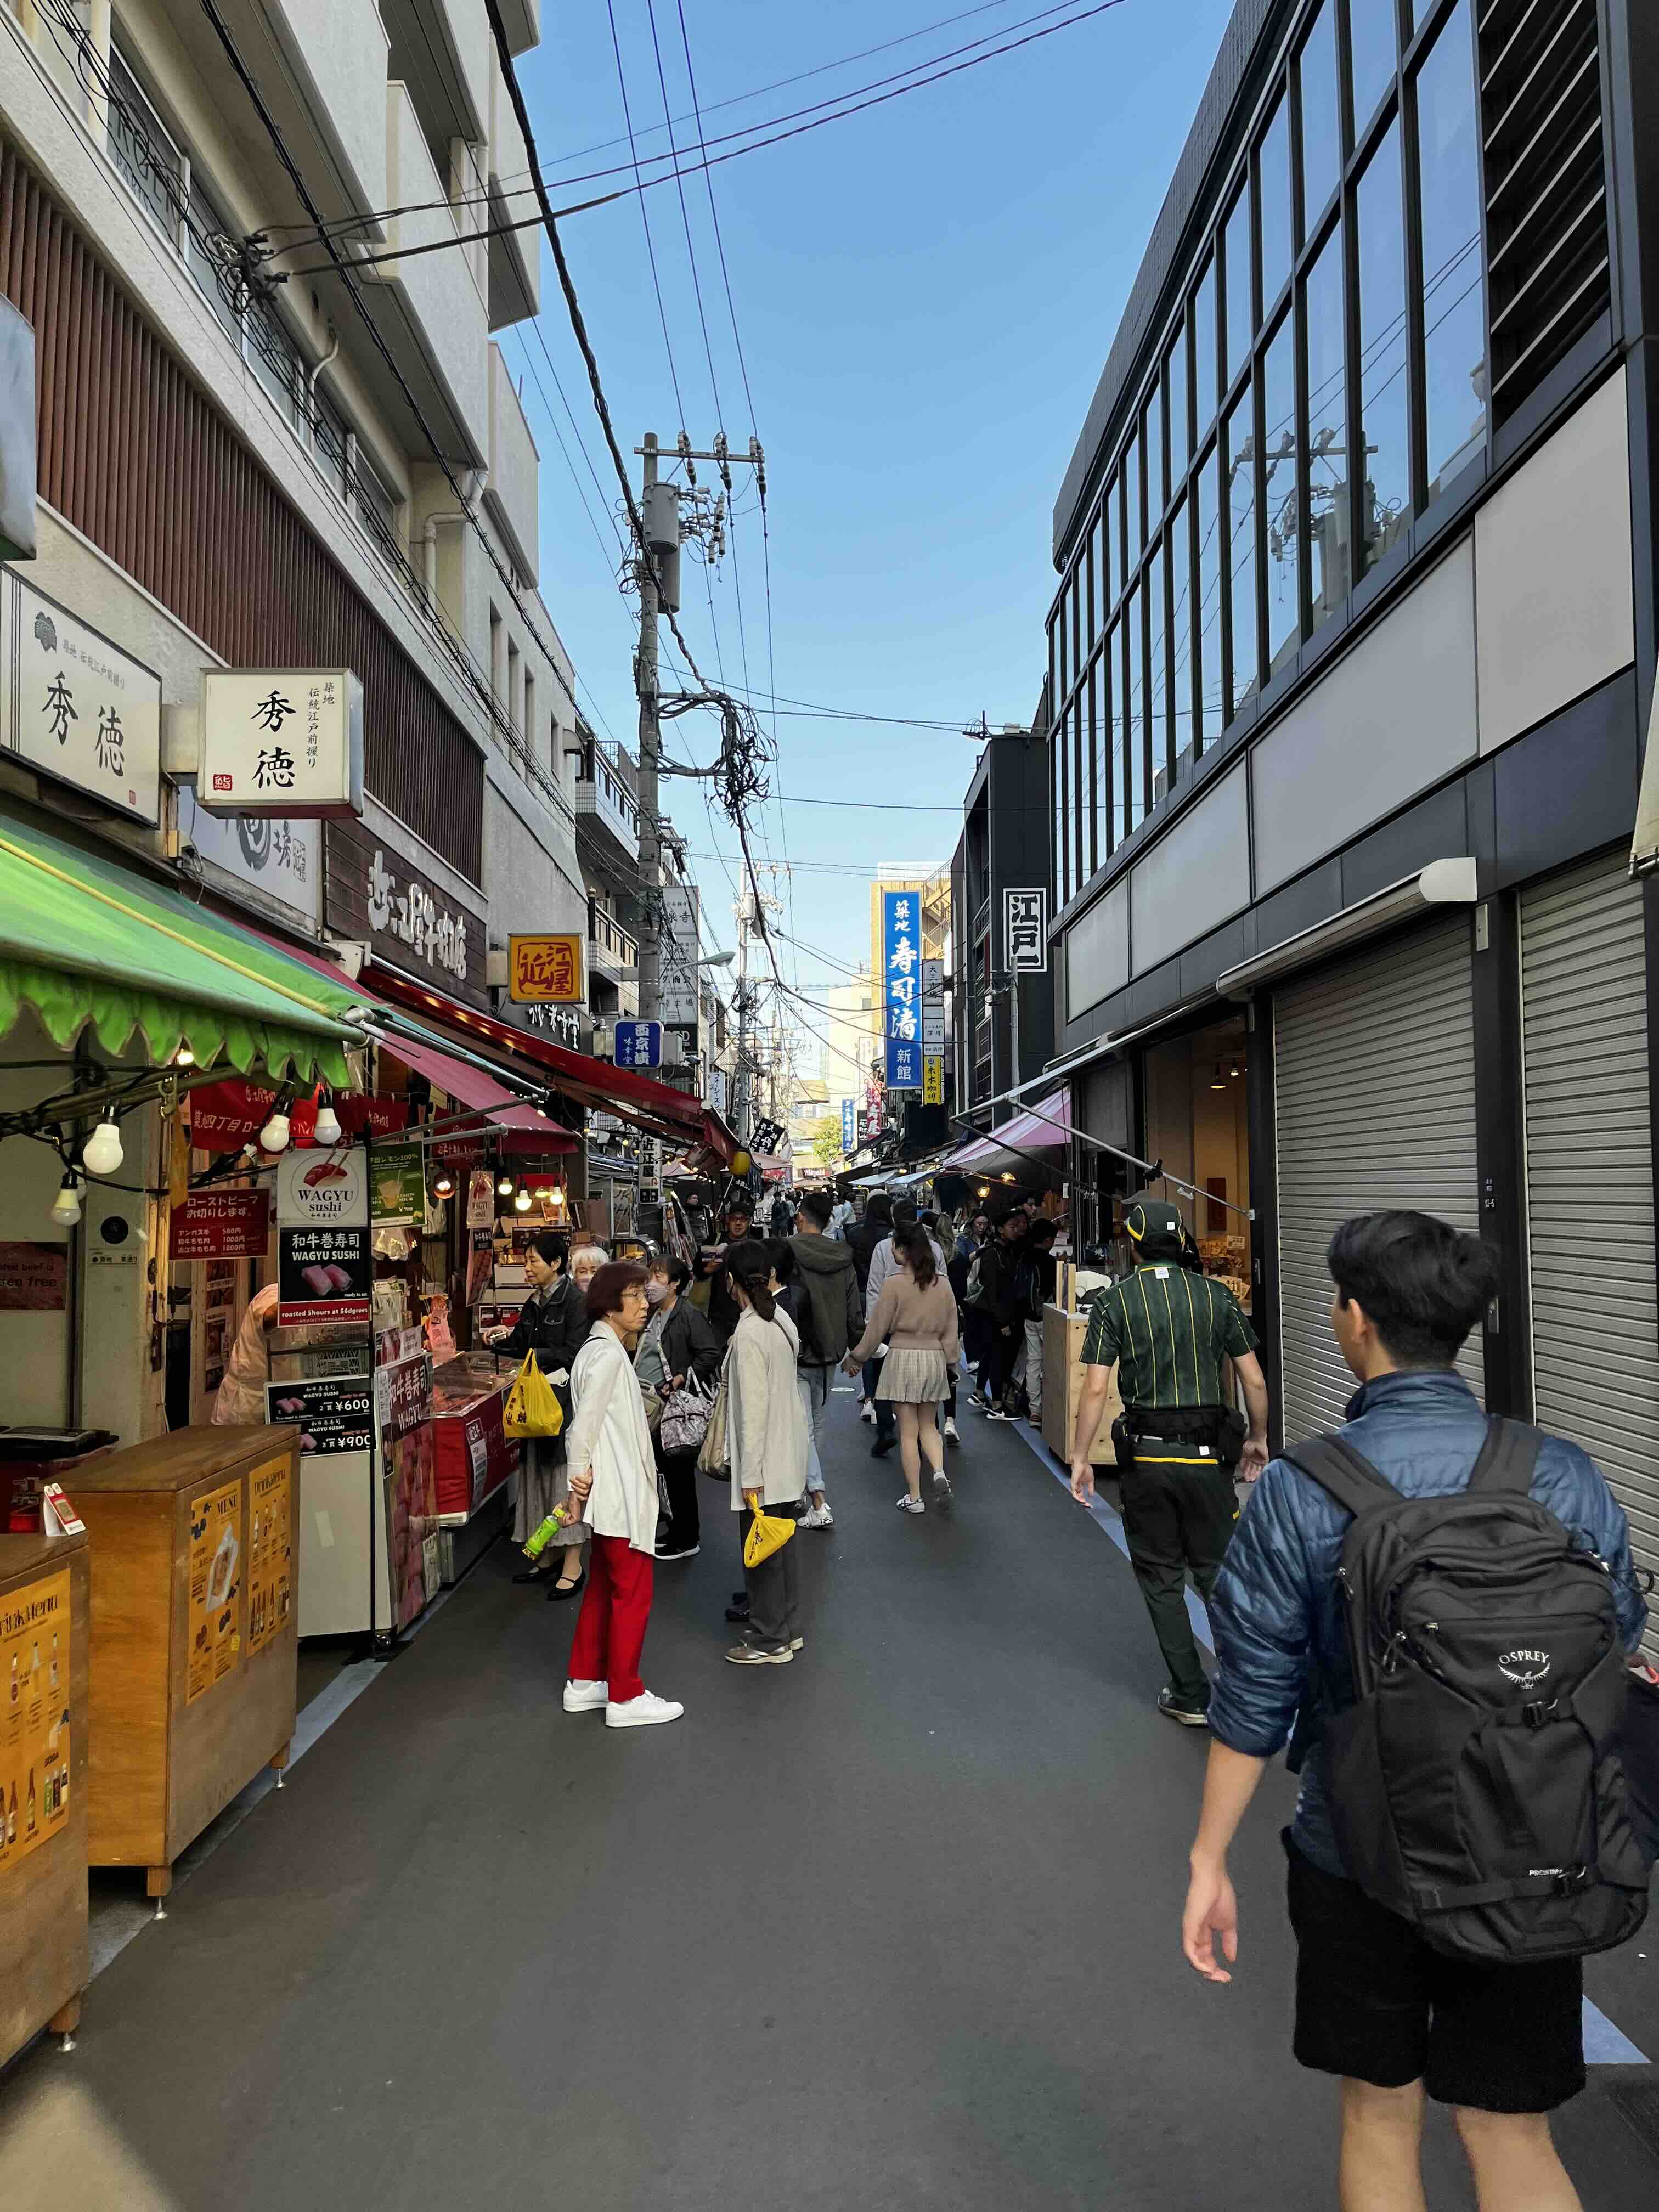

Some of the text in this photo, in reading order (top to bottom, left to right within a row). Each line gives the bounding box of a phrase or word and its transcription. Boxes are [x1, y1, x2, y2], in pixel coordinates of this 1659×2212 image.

[322, 682, 335, 704] 築地
[42, 670, 125, 777] 秀徳
[305, 687, 320, 769] 伝統江戸前握り
[250, 689, 297, 789] 秀徳
[893, 899, 911, 933] 築地
[1011, 894, 1039, 966] 江戸一
[520, 945, 571, 993] 近江屋
[888, 936, 918, 1041] 寿司清
[634, 1023, 650, 1065] 西京漬
[896, 1048, 912, 1081] 新館
[187, 1195, 258, 1207] ローストビーフ
[298, 1190, 354, 1201] WAGYU
[309, 1201, 342, 1212] sushi
[187, 1207, 252, 1219] お切りします。
[292, 1233, 360, 1249] 和牛巻寿司
[291, 1250, 360, 1261] WAGYU SUSHI
[281, 1309, 306, 1318] roasted
[307, 1307, 330, 1316] 5hours
[335, 1398, 369, 1412] ¥600
[398, 1402, 423, 1431] WAGYU
[1499, 1650, 1550, 1664] OSPREY
